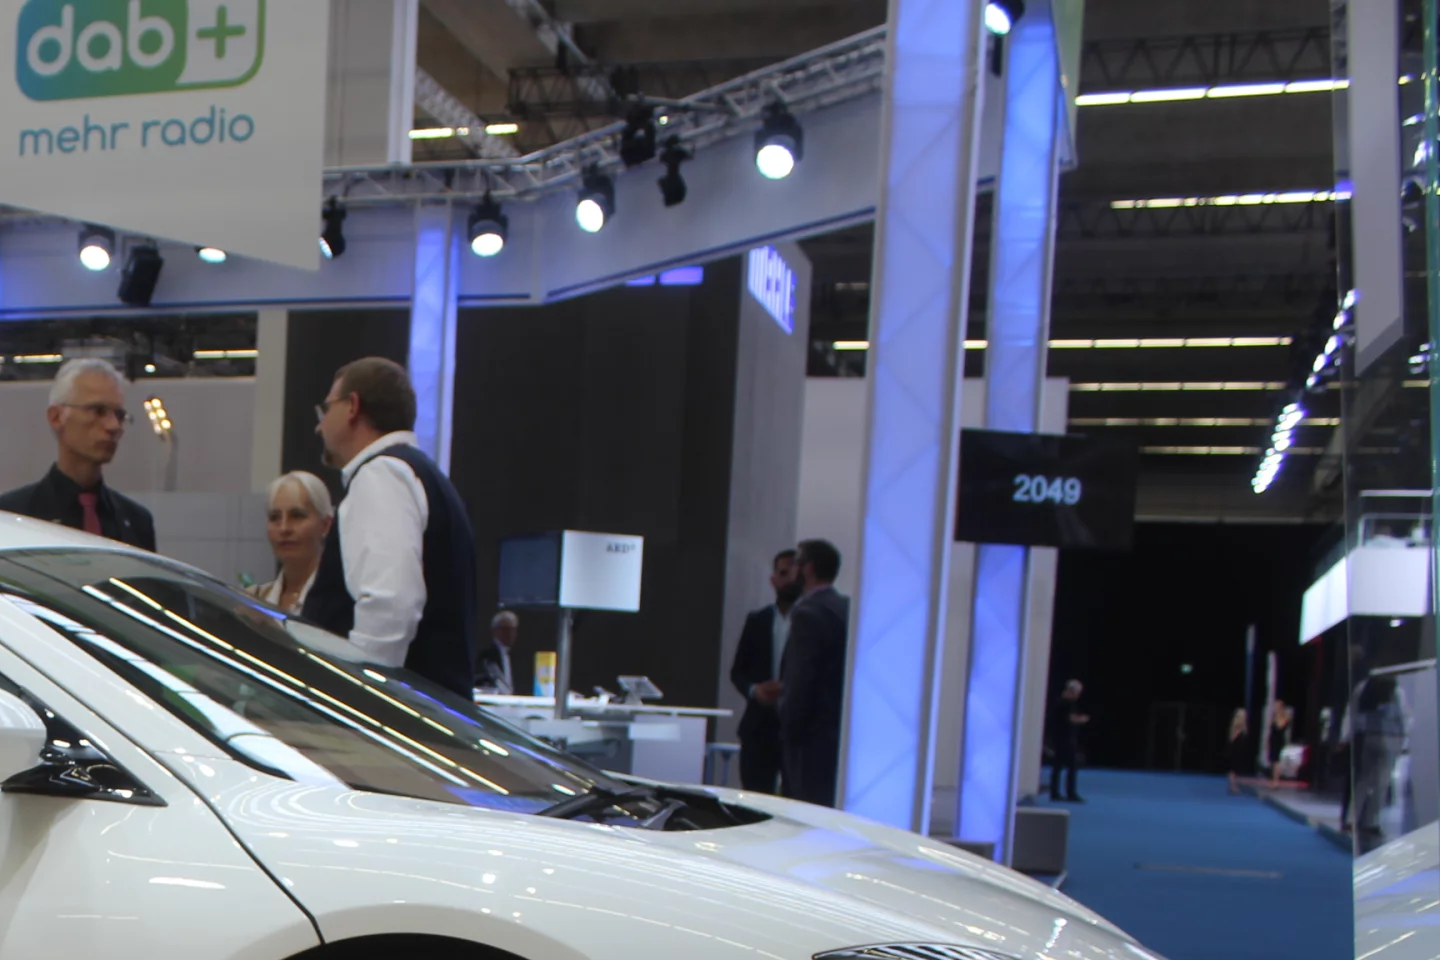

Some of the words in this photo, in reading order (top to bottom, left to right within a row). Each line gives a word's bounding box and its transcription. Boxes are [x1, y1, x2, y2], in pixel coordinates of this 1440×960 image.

[26, 0, 247, 77] dab+
[19, 114, 130, 156] mehr
[141, 104, 255, 148] radio
[1012, 474, 1082, 505] 2049
